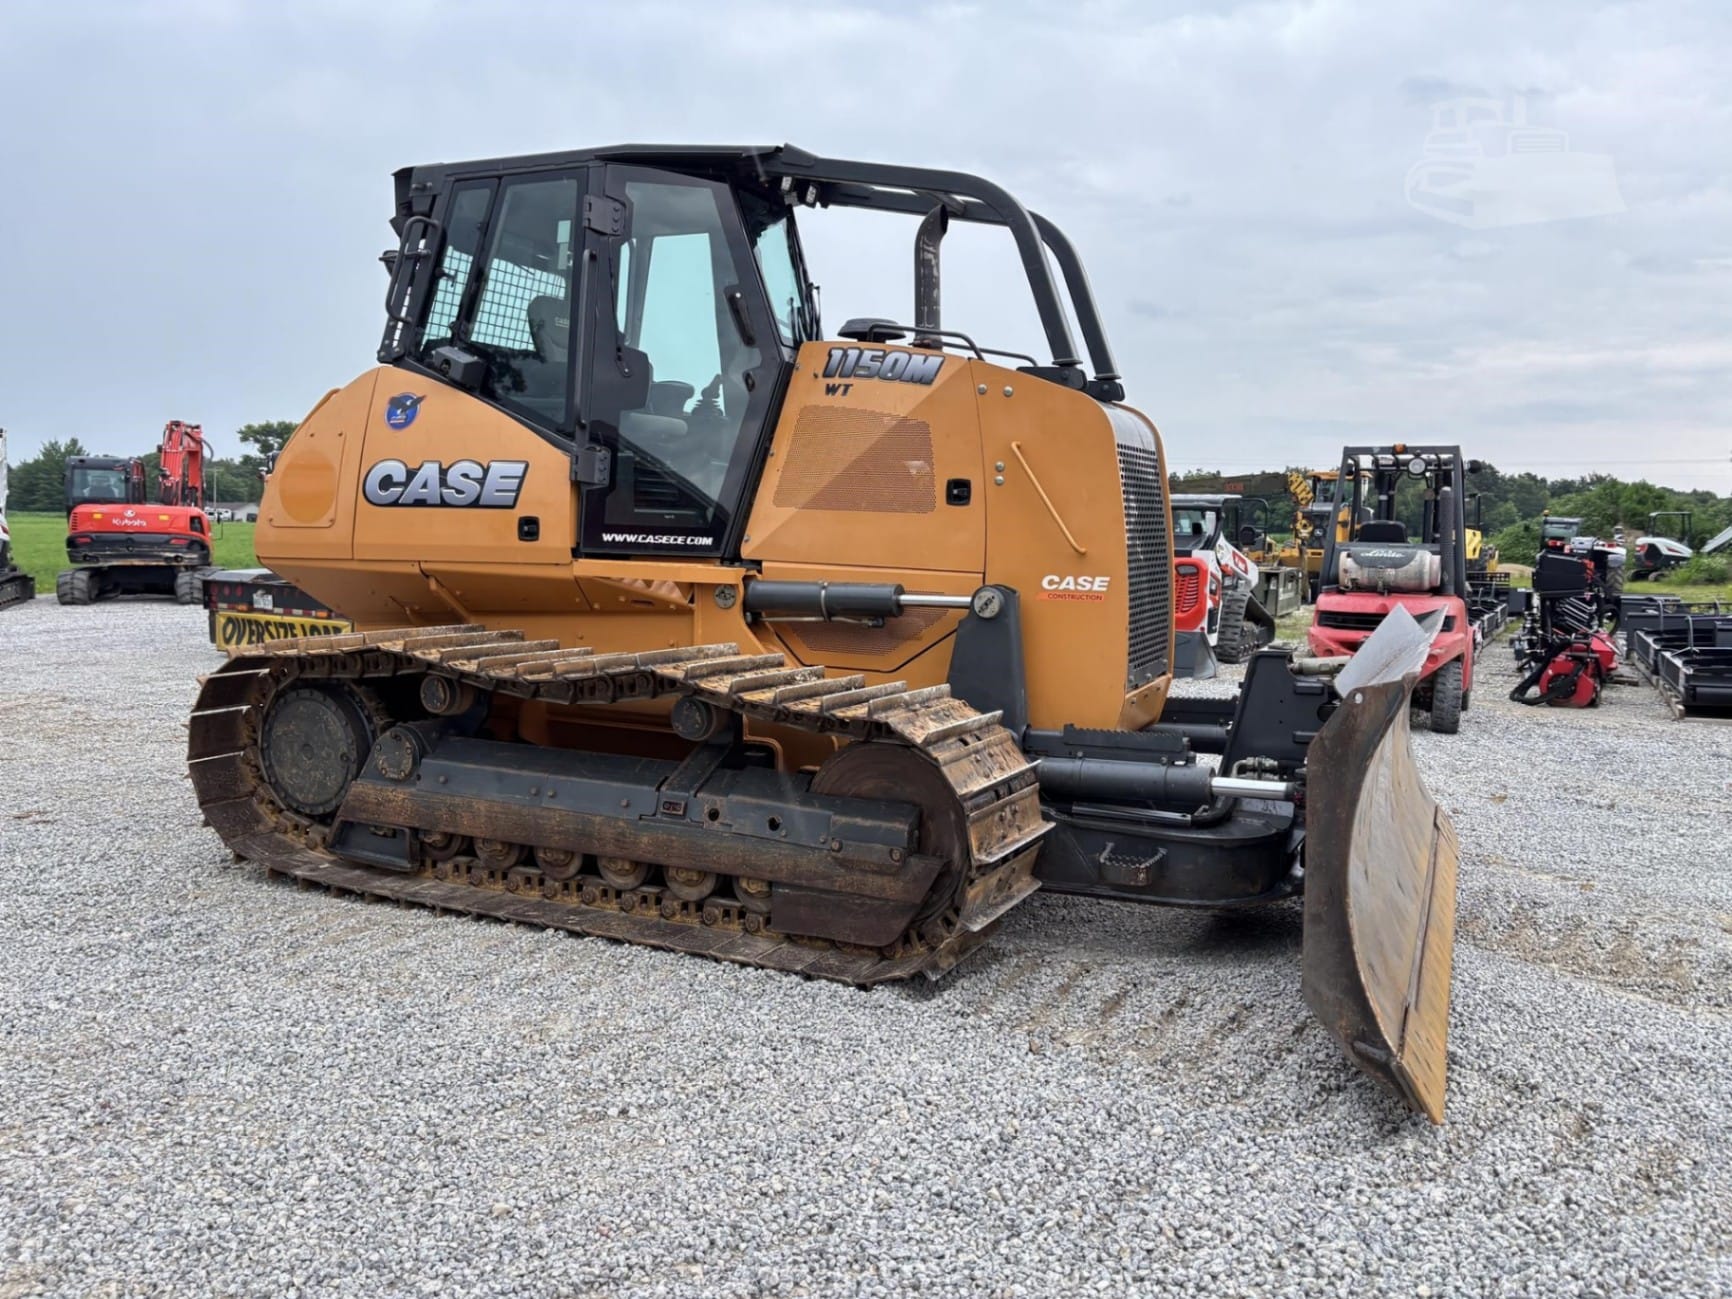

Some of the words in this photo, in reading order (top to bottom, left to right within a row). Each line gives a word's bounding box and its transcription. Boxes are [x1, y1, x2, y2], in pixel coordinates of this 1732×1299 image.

[823, 347, 945, 385] 1150M
[825, 383, 853, 396] WT
[363, 459, 528, 508] CASE
[112, 517, 147, 527] Kubota
[1041, 575, 1111, 591] CASE
[1047, 592, 1103, 601] CONSTRUCTION
[222, 616, 298, 645] OVERSIZE
